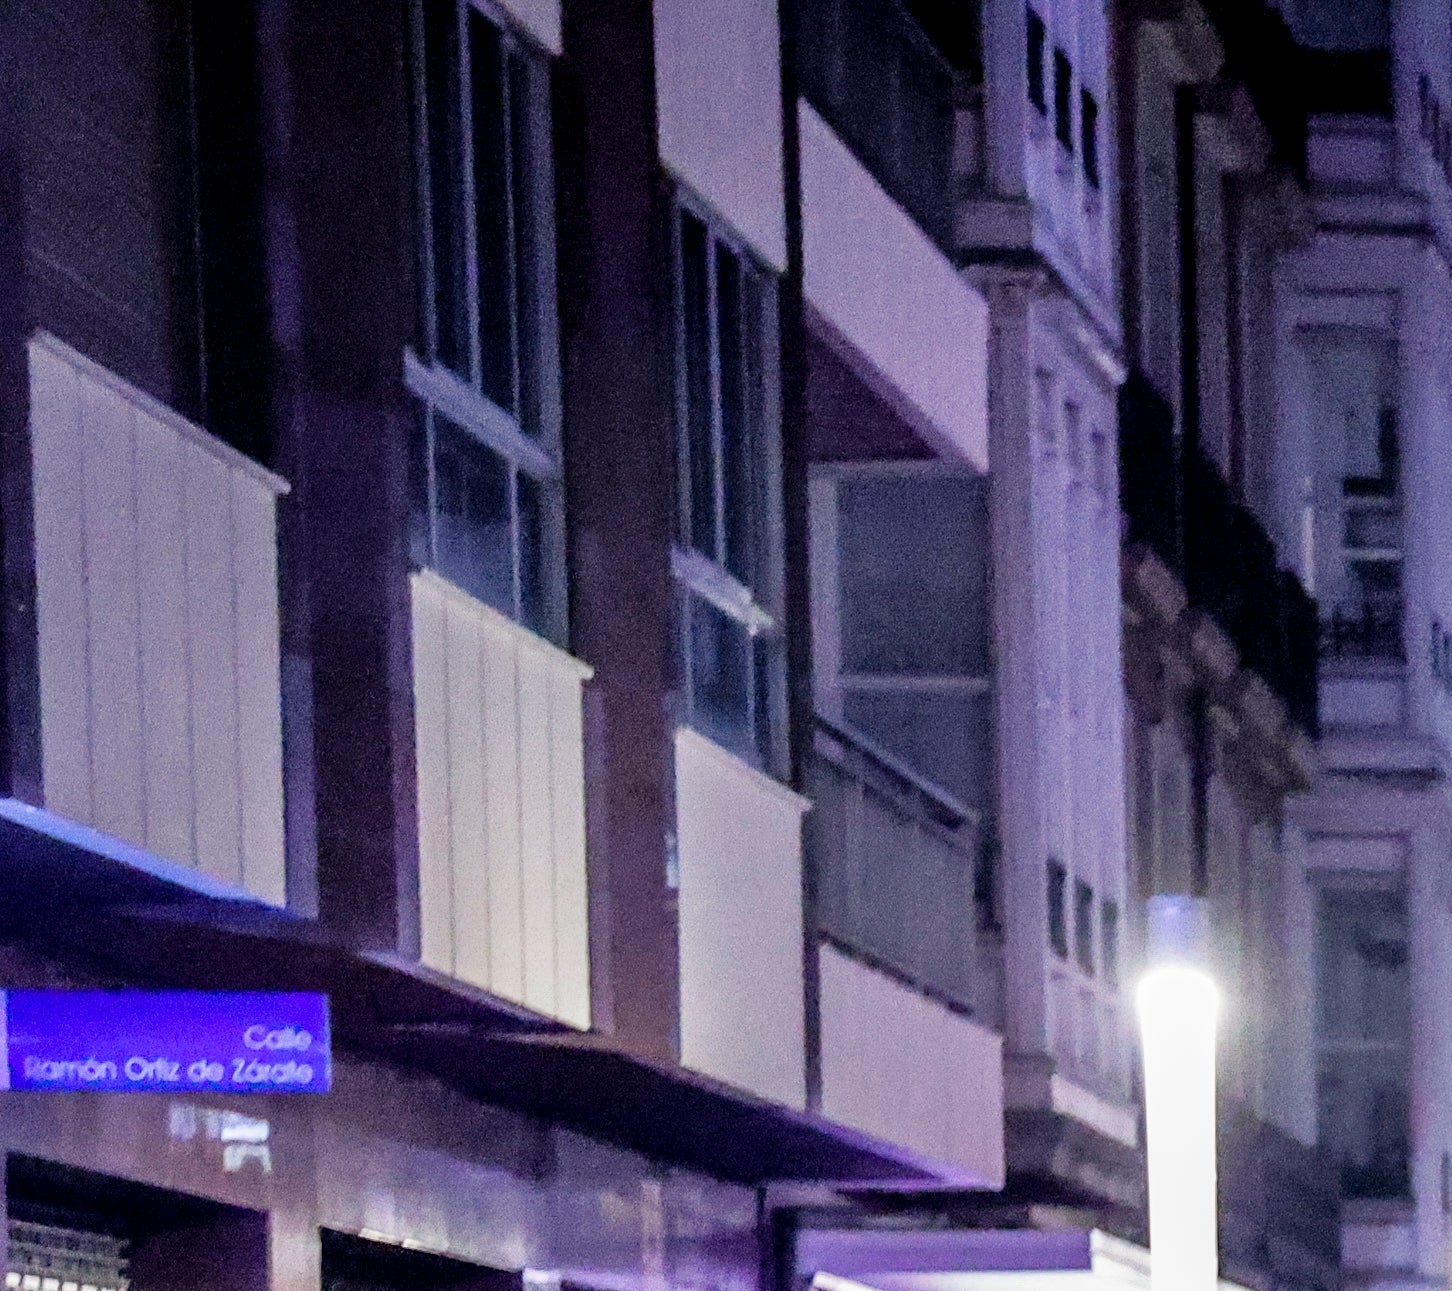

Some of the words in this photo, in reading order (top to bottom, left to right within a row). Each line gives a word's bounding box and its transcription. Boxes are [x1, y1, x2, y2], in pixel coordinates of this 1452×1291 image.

[243, 1024, 313, 1051] Calle
[24, 1055, 118, 1081] Ramón
[125, 1056, 180, 1082] Ortiz
[187, 1058, 225, 1083] de
